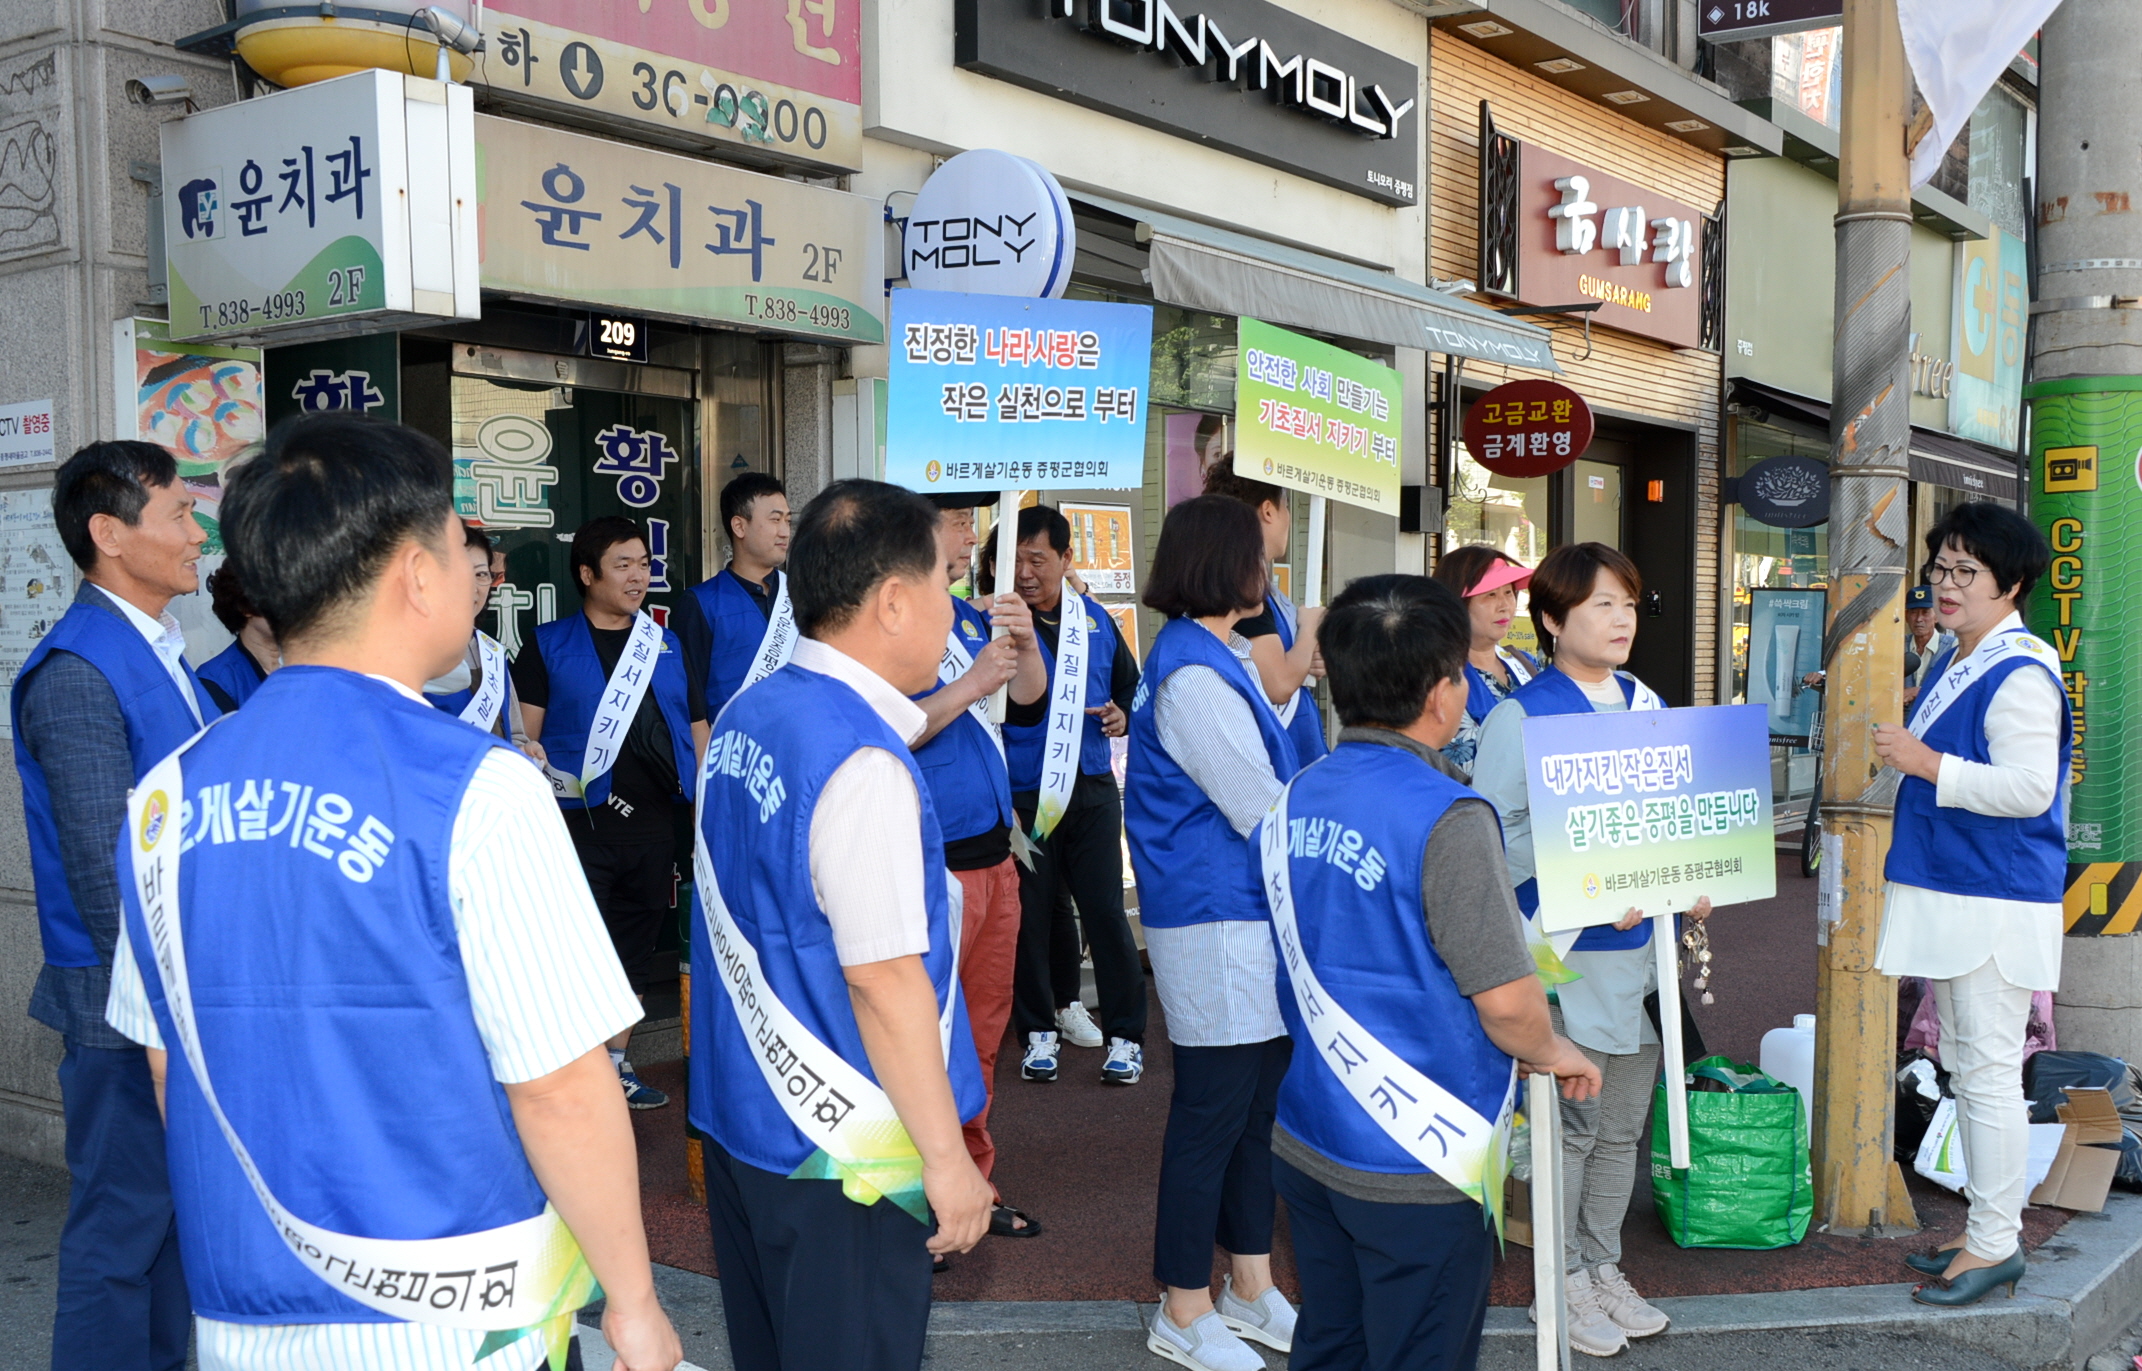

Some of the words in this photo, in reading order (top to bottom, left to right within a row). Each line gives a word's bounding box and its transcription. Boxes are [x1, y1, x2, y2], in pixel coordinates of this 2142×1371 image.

[1734, 2, 1770, 20] 18k
[497, 28, 538, 87] 하
[1062, 0, 1413, 138] ONYMOLY
[230, 136, 371, 237] 윤치과
[1367, 170, 1393, 190] 토니모리
[1394, 179, 1413, 199] 증평점
[520, 162, 776, 283] 윤치과
[802, 243, 842, 284] 2F
[912, 211, 1037, 244] TONY
[1549, 175, 1694, 288] 금사랑
[911, 238, 1036, 271] MOLY
[329, 266, 364, 307] 2F
[1579, 274, 1652, 313] GUMSARANG
[200, 290, 305, 330] T.838-4993
[745, 294, 850, 330] T.838-4993
[600, 319, 635, 346] 209
[905, 323, 977, 363] 진정한
[984, 328, 1099, 368] 나라사랑은
[1426, 325, 1541, 364] TONYMOLY
[941, 383, 988, 421] 작은
[996, 386, 1086, 421] 실천으로
[1094, 388, 1137, 423] 부터
[1246, 347, 1297, 389] 안전한
[1301, 364, 1333, 402] 사회
[1336, 381, 1389, 423] 만들기는
[23, 413, 50, 435] 촬영중
[1259, 400, 1322, 446] 기초질서
[1325, 418, 1369, 456] 지키기
[1370, 433, 1397, 465] 부터
[1482, 399, 1573, 426] 고금교환
[1482, 430, 1572, 459] 금계환영
[945, 460, 1032, 481] 바르게살기운동
[1036, 459, 1109, 480] 증평군협의회
[1276, 462, 1334, 490] 바르게살기운동
[1334, 477, 1382, 504] 증평군협의회
[1113, 572, 1131, 590] 증정
[2050, 518, 2083, 663] CCTV
[470, 648, 500, 728] 기초질
[1911, 639, 2010, 738] 기초질
[1545, 755, 1620, 792] 내가지킨
[1623, 748, 1691, 788] 작은질서
[1568, 803, 1640, 848] 살기좋은
[1645, 798, 1693, 839] 증평을
[1697, 792, 1757, 832] 만듭니다
[1605, 864, 1681, 893] 바르게살기운동
[1684, 856, 1743, 882] 증평군협의회
